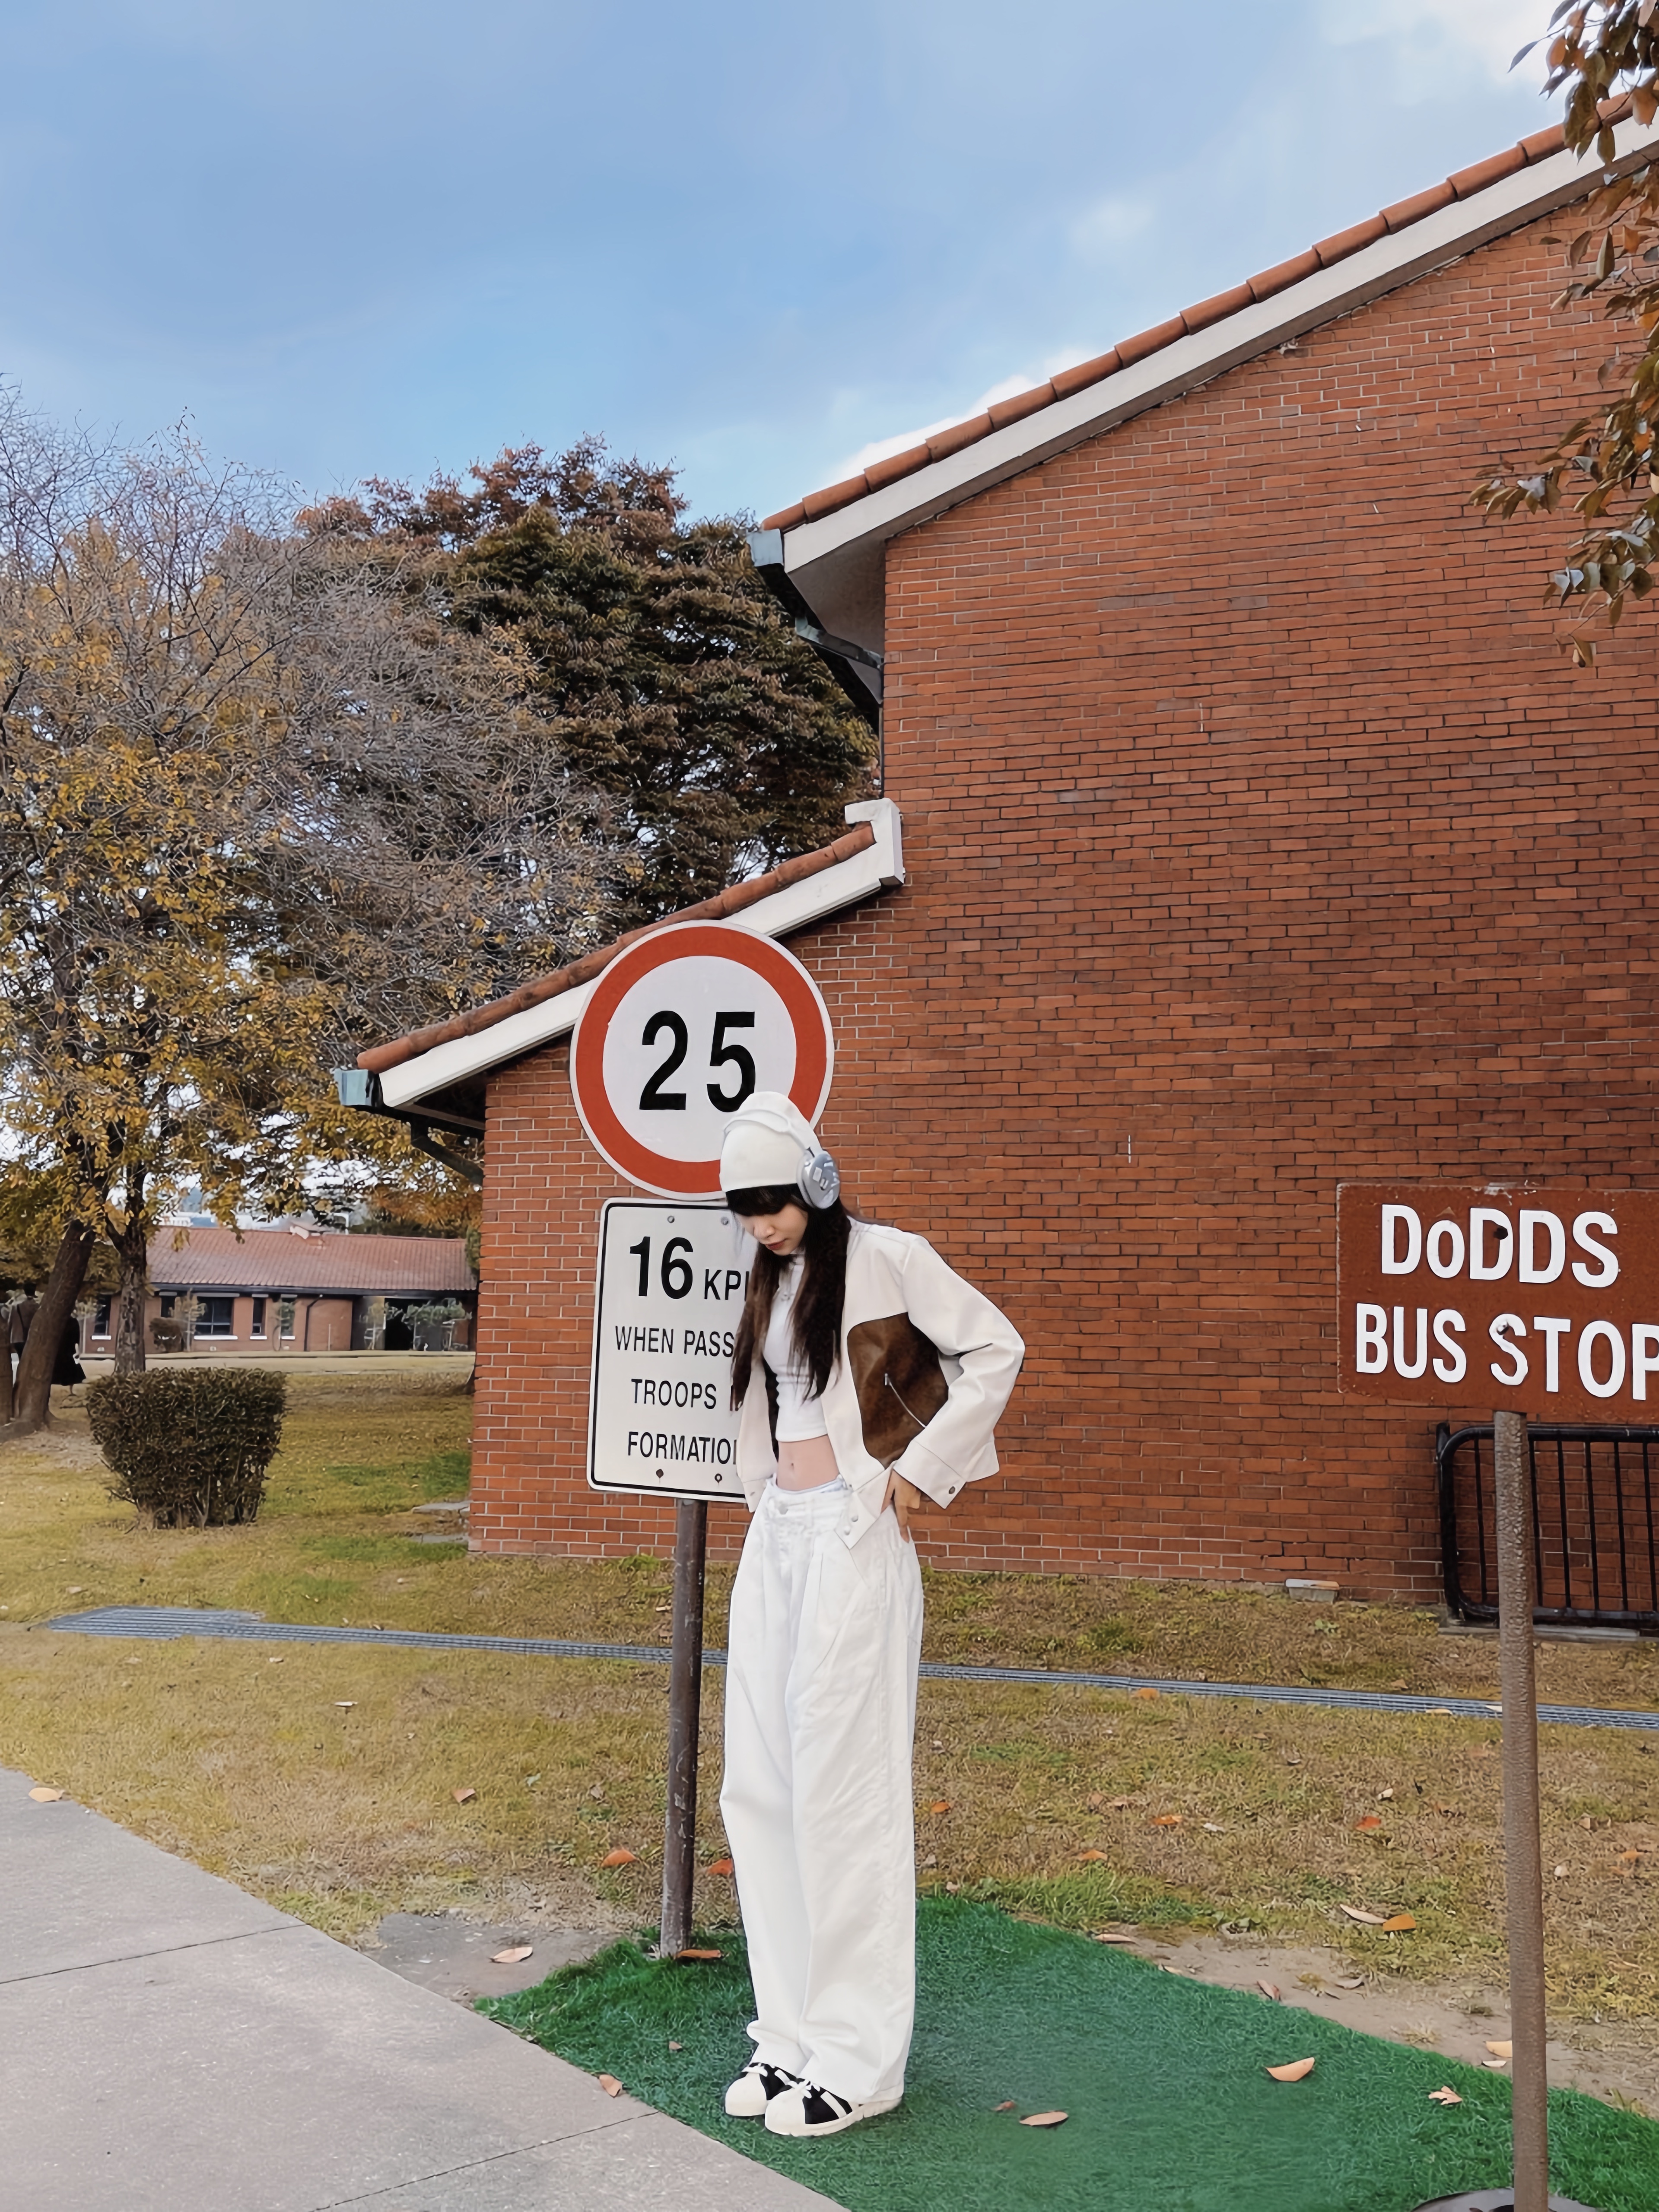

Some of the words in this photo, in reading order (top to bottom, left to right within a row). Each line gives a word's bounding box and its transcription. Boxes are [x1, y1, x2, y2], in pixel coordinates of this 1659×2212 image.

[639, 1010, 756, 1113] 25
[629, 1236, 694, 1300] 16
[704, 1268, 750, 1302] KP
[1381, 1204, 1621, 1288] DoDDS
[615, 1325, 674, 1354] WHEN
[1356, 1302, 1467, 1383] BUS
[1488, 1313, 1659, 1401] STOP
[630, 1378, 717, 1410] TROOPS
[627, 1431, 737, 1465] FORMATIO
